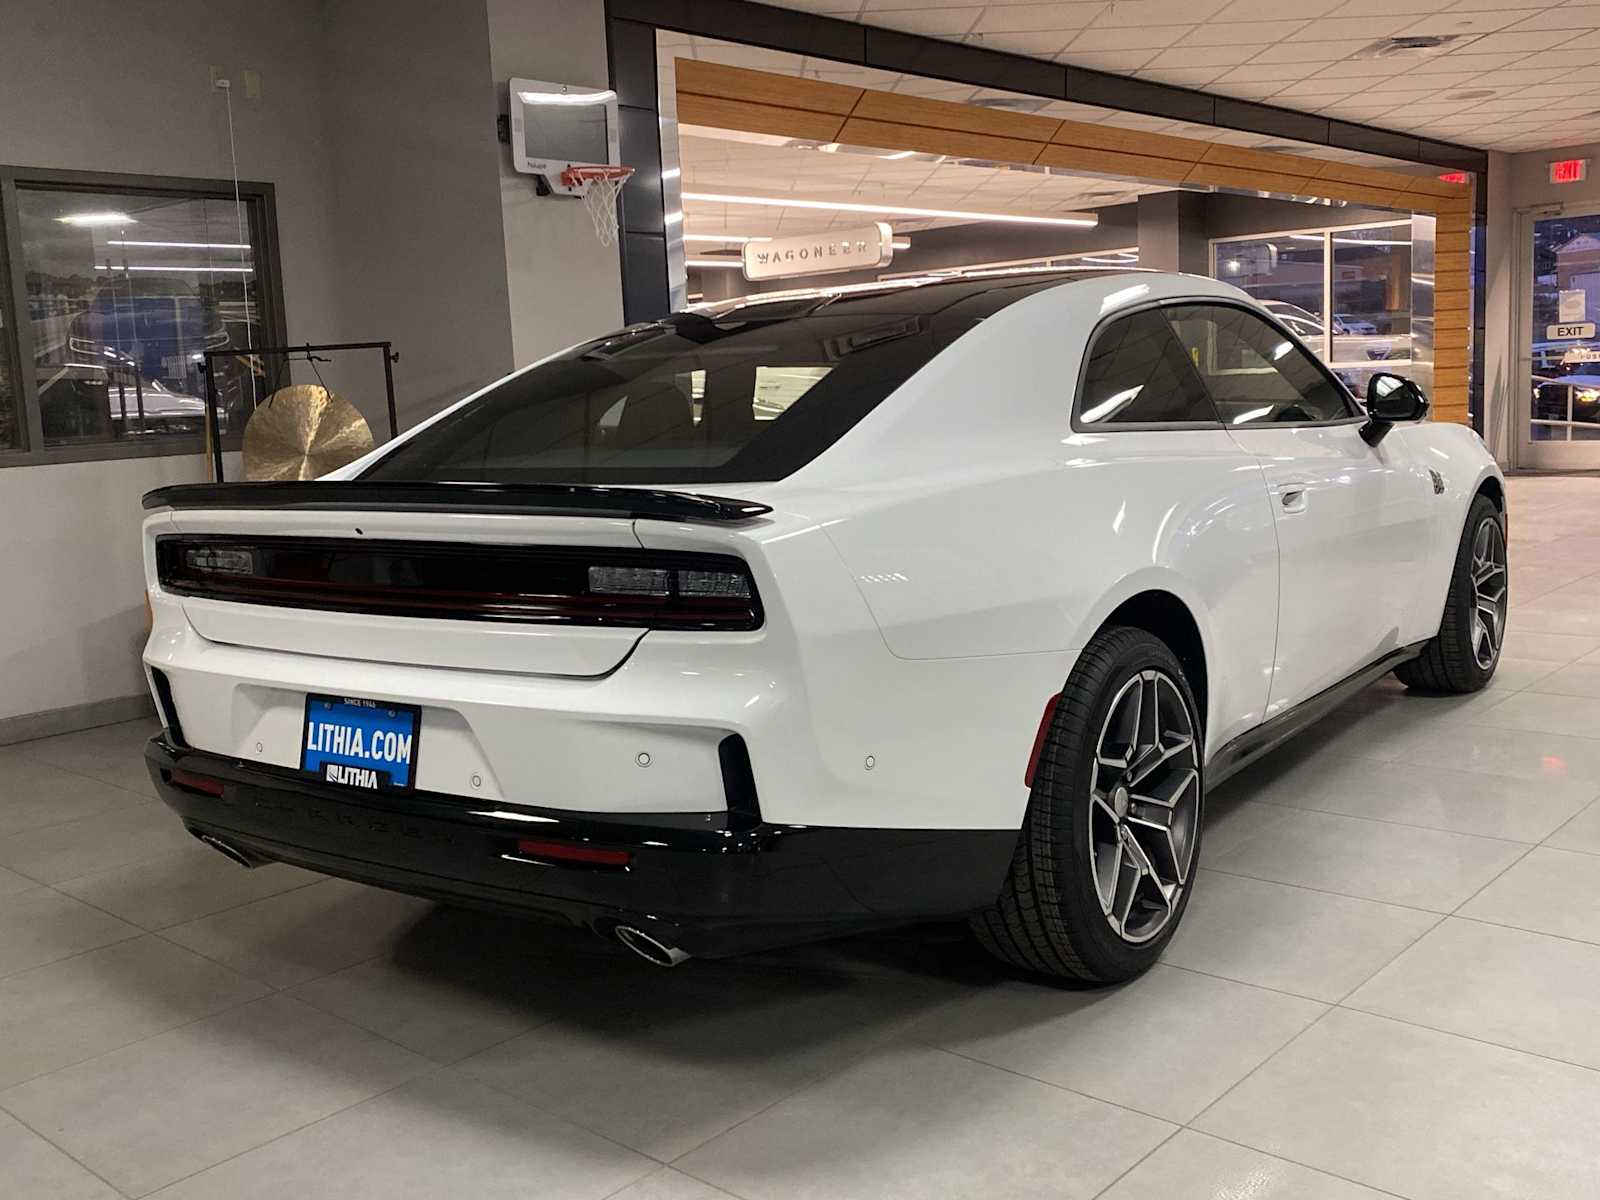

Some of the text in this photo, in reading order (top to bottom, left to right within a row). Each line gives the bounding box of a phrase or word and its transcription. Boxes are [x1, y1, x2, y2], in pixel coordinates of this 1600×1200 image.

[757, 241, 867, 264] WAGONEER
[1557, 326, 1584, 337] EXIT
[343, 697, 361, 707] SINCE
[307, 721, 413, 765] LITHIA.COM
[337, 765, 378, 790] LITHIA
